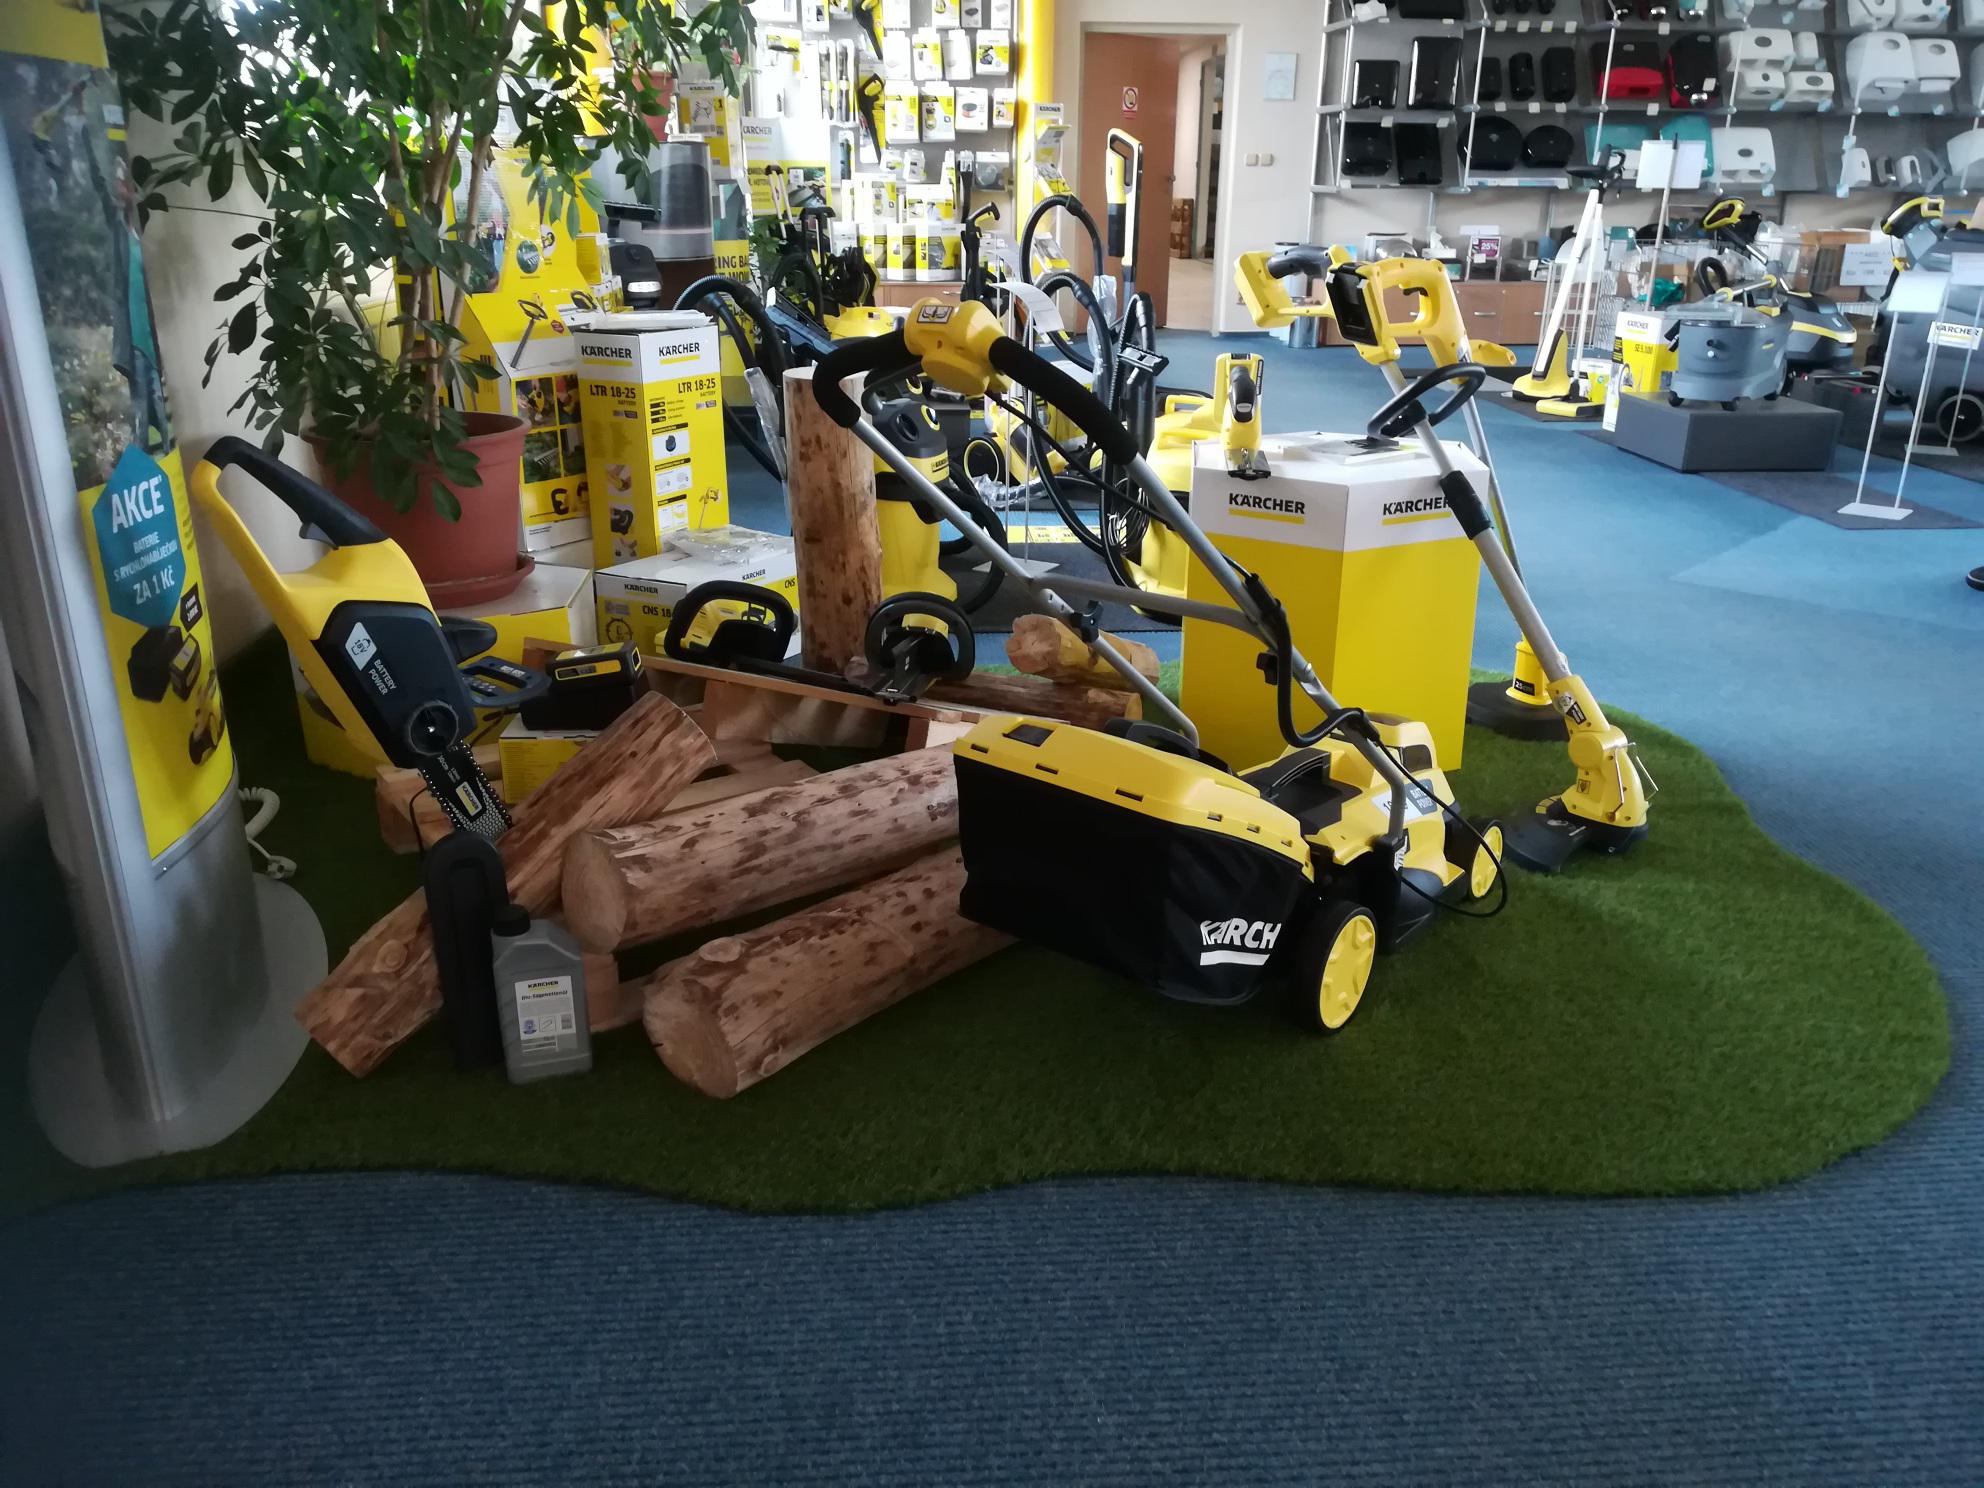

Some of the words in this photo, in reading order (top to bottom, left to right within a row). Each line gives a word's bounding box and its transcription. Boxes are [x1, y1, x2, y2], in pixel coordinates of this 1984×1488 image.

[581, 345, 632, 359] KÄRCHER
[658, 342, 700, 357] KÄRCHER
[590, 384, 608, 397] LTR
[610, 386, 636, 399] 18-25
[678, 381, 692, 394] LTR
[694, 377, 716, 391] 18-25
[1228, 492, 1306, 514] KÄRCHER
[133, 578, 152, 605] ZA
[154, 572, 161, 594] 1
[160, 565, 176, 590] Kč
[624, 583, 659, 594] KÄRCHER
[784, 578, 796, 589] CNS
[642, 605, 659, 616] CNS
[368, 668, 388, 695] POWER
[373, 658, 397, 690] BATTERY
